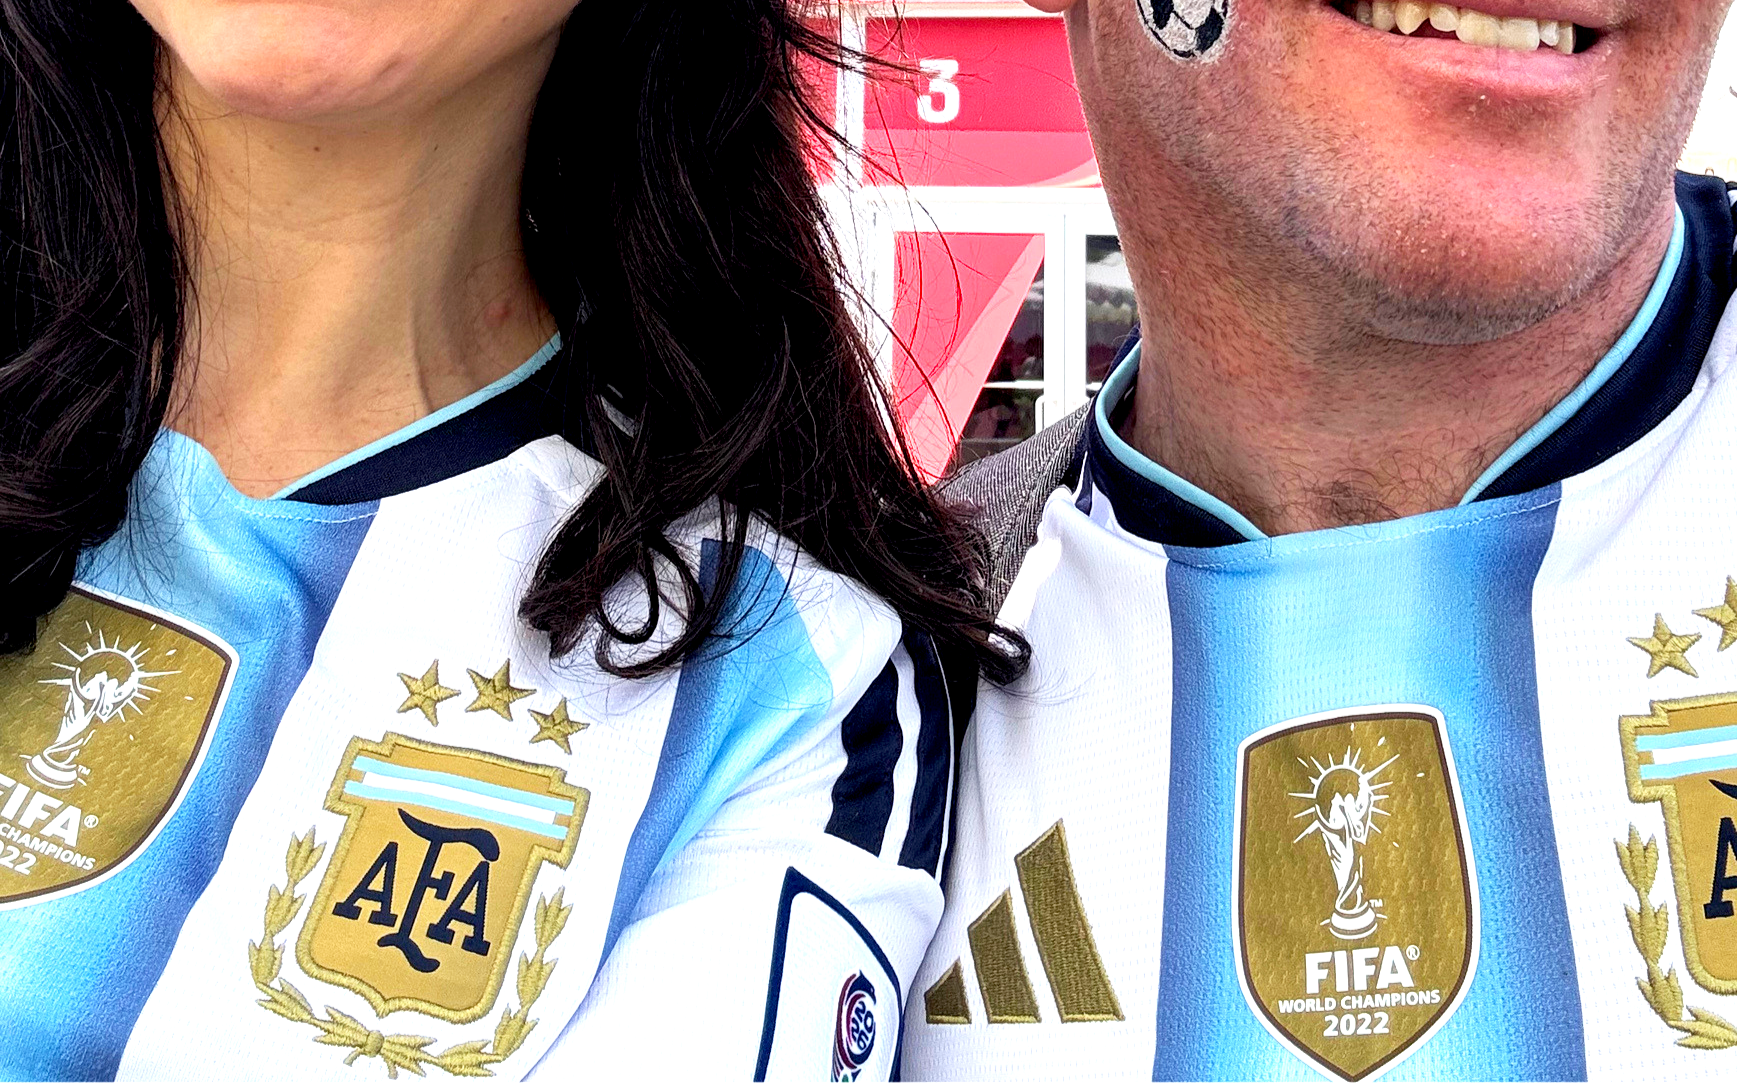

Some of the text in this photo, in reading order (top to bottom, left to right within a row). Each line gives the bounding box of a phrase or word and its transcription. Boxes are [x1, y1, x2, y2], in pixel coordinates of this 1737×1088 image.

[916, 59, 960, 123] 3
[0, 823, 96, 870] CHAMPIONS
[332, 808, 500, 973] AFA
[1278, 989, 1440, 1013] WORLD CHAMPIONS
[1323, 1012, 1389, 1037] 2022
